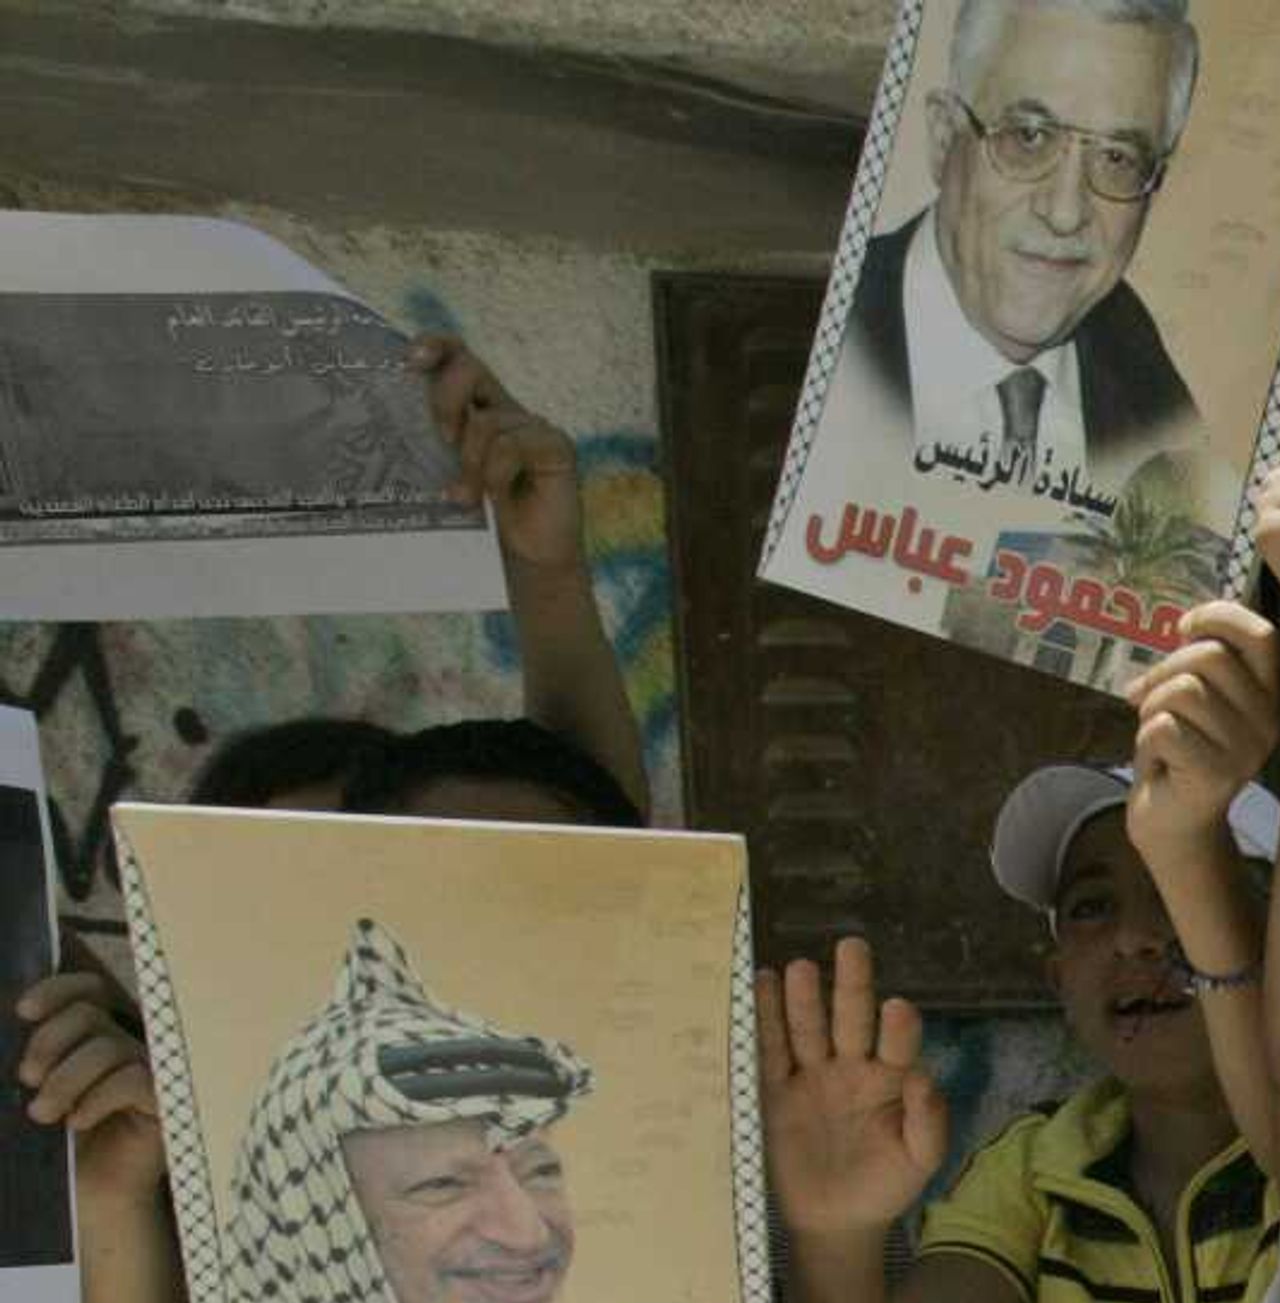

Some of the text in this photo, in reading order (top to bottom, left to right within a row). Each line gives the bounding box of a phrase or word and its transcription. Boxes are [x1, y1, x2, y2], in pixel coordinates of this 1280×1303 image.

[913, 430, 1118, 518] سيادة الرئيس
[804, 500, 1190, 656] محمود عباس
